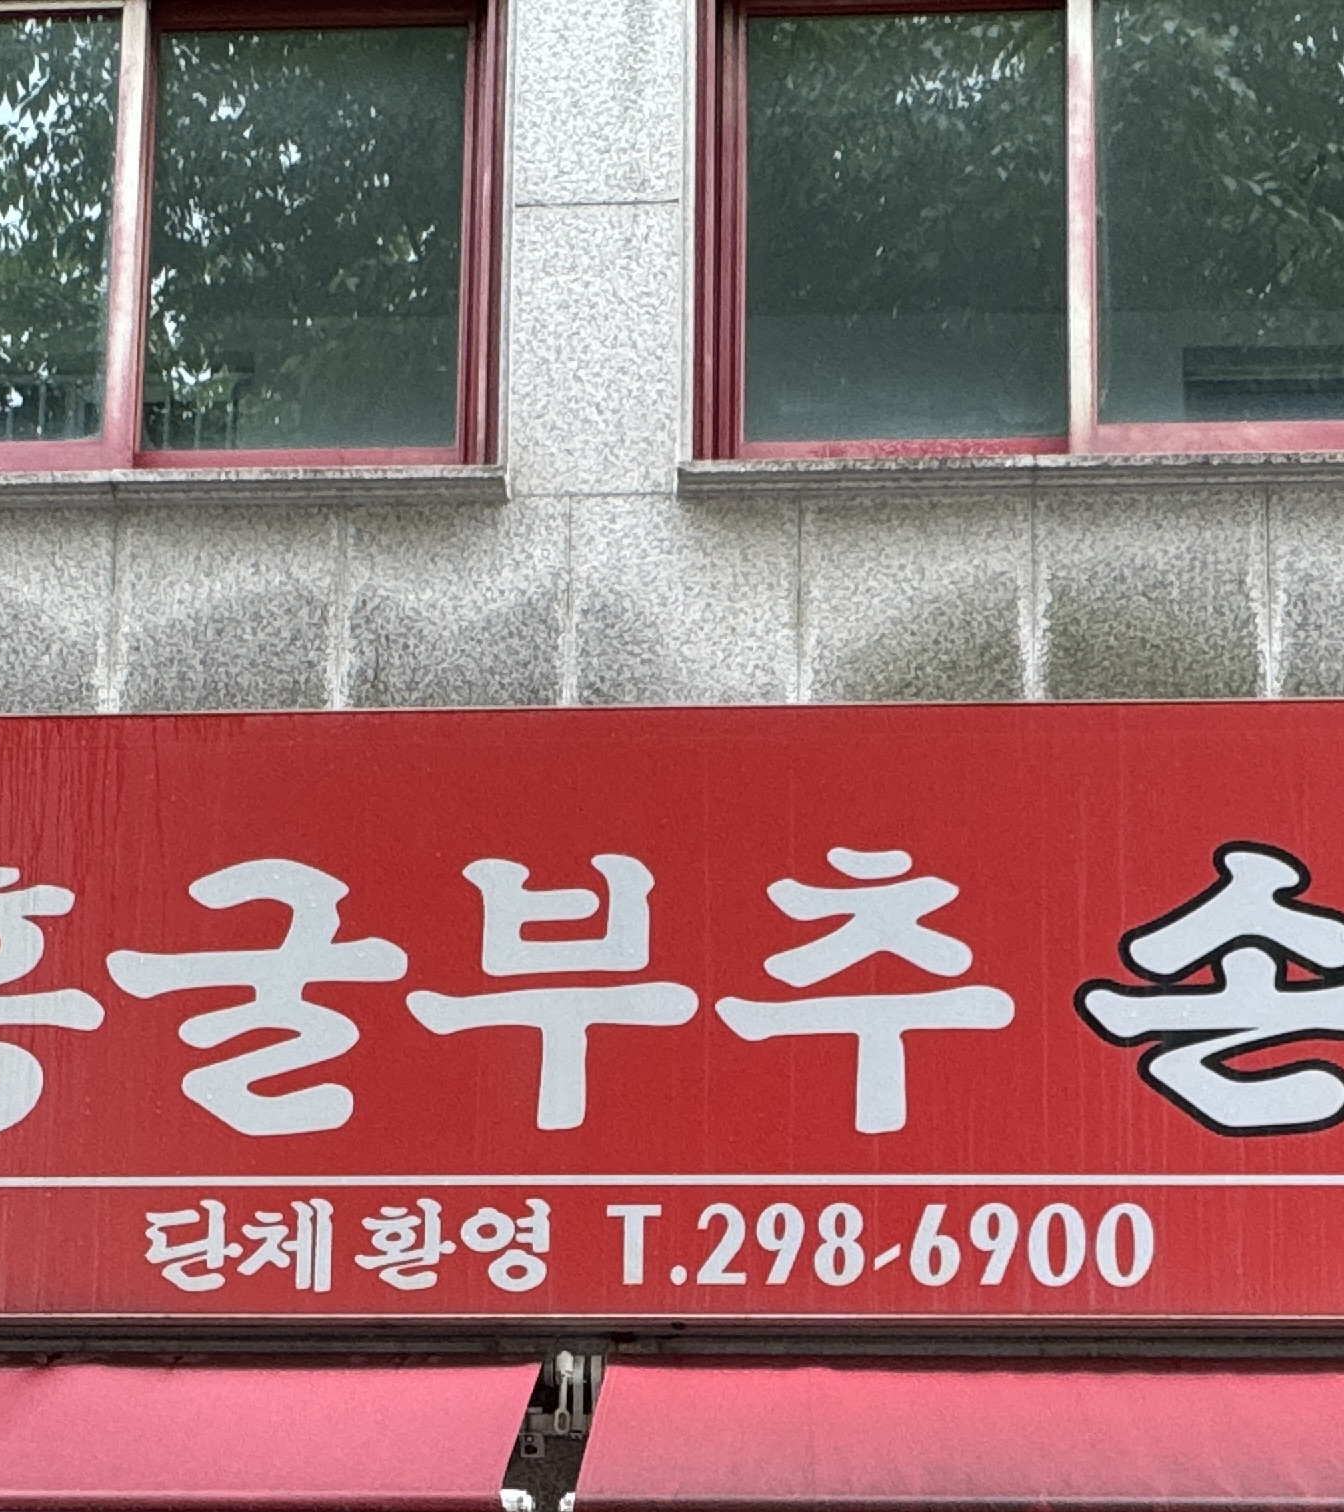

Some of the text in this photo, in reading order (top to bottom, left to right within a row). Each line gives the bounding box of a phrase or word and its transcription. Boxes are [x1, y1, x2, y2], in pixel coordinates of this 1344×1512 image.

[143, 1197, 1156, 1294] 단체 환영 T.298-6900
